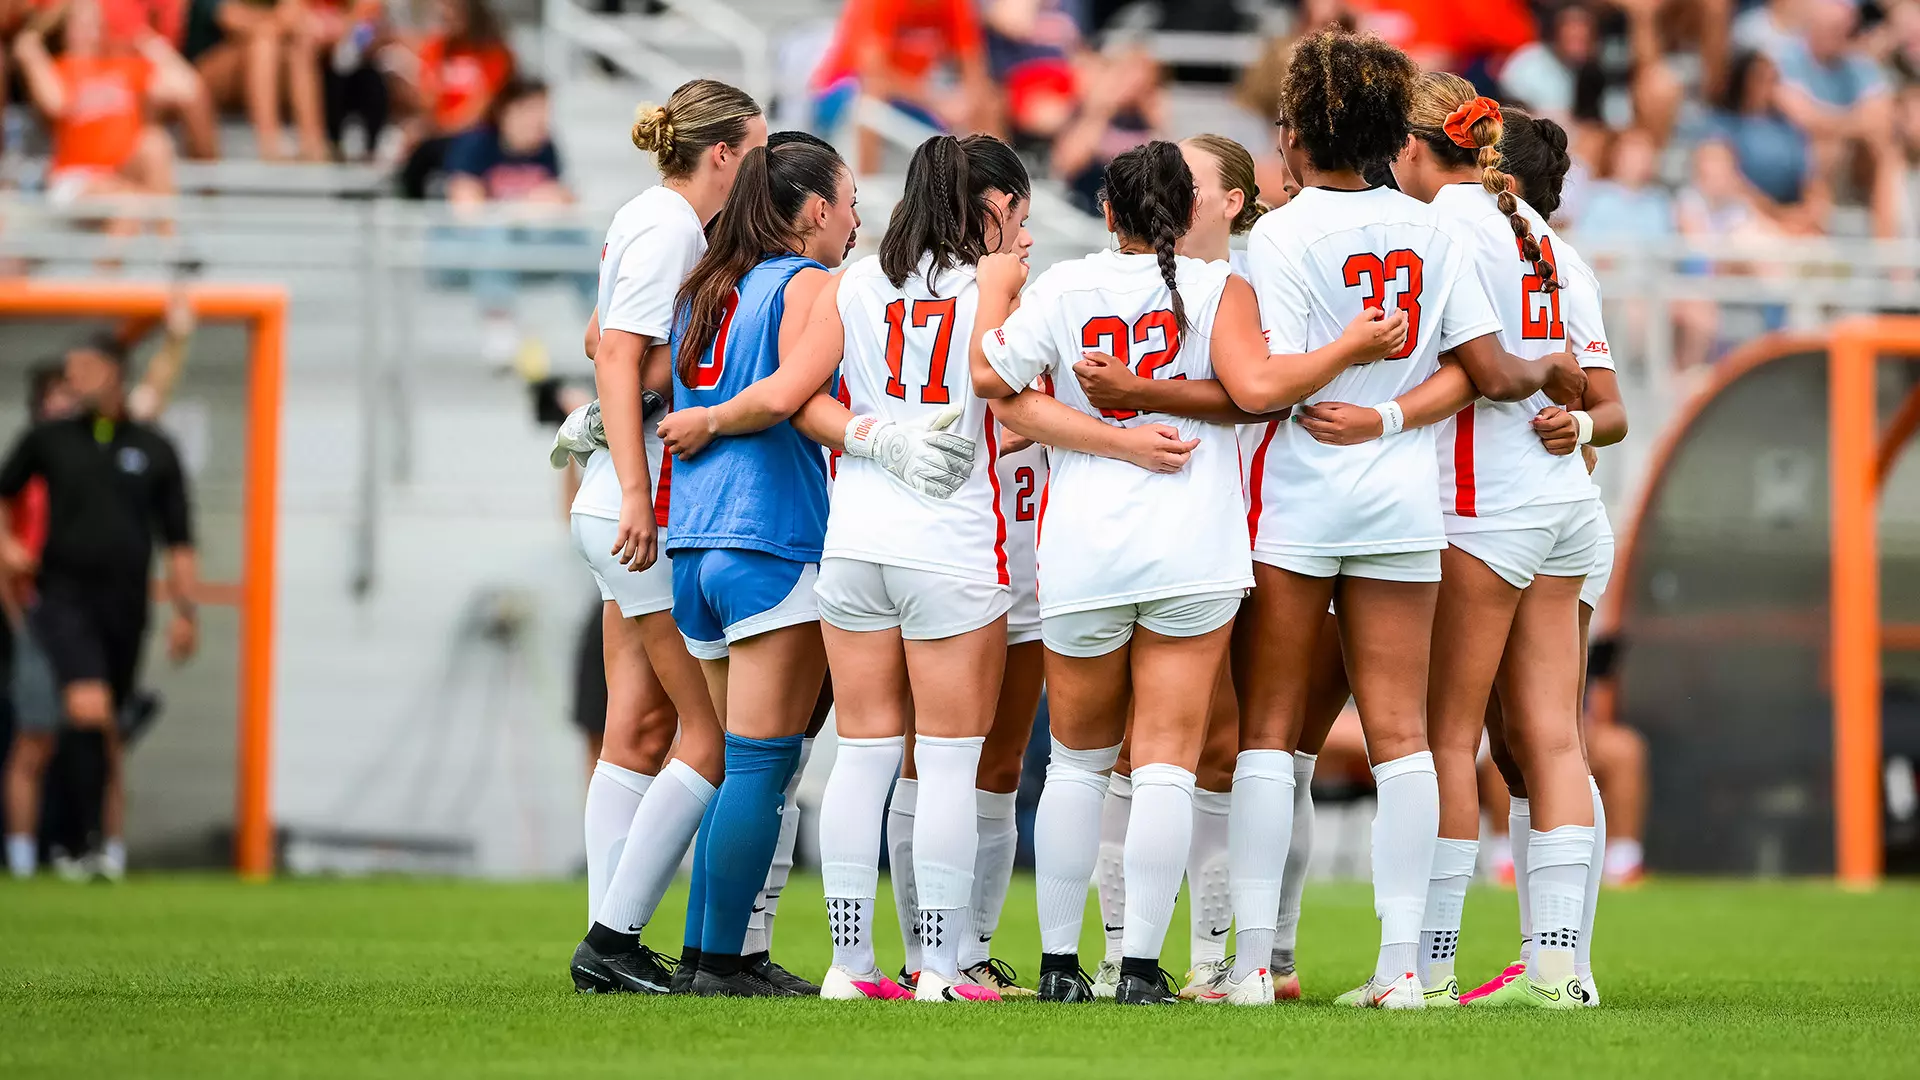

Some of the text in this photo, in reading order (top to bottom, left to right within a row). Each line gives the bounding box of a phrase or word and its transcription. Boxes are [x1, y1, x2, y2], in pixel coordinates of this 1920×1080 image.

[1342, 248, 1424, 365] 33
[1515, 233, 1566, 340] 21
[884, 296, 958, 404] 17
[1082, 308, 1188, 421] 22
[1583, 340, 1609, 354] ACC
[1014, 465, 1035, 521] 2
